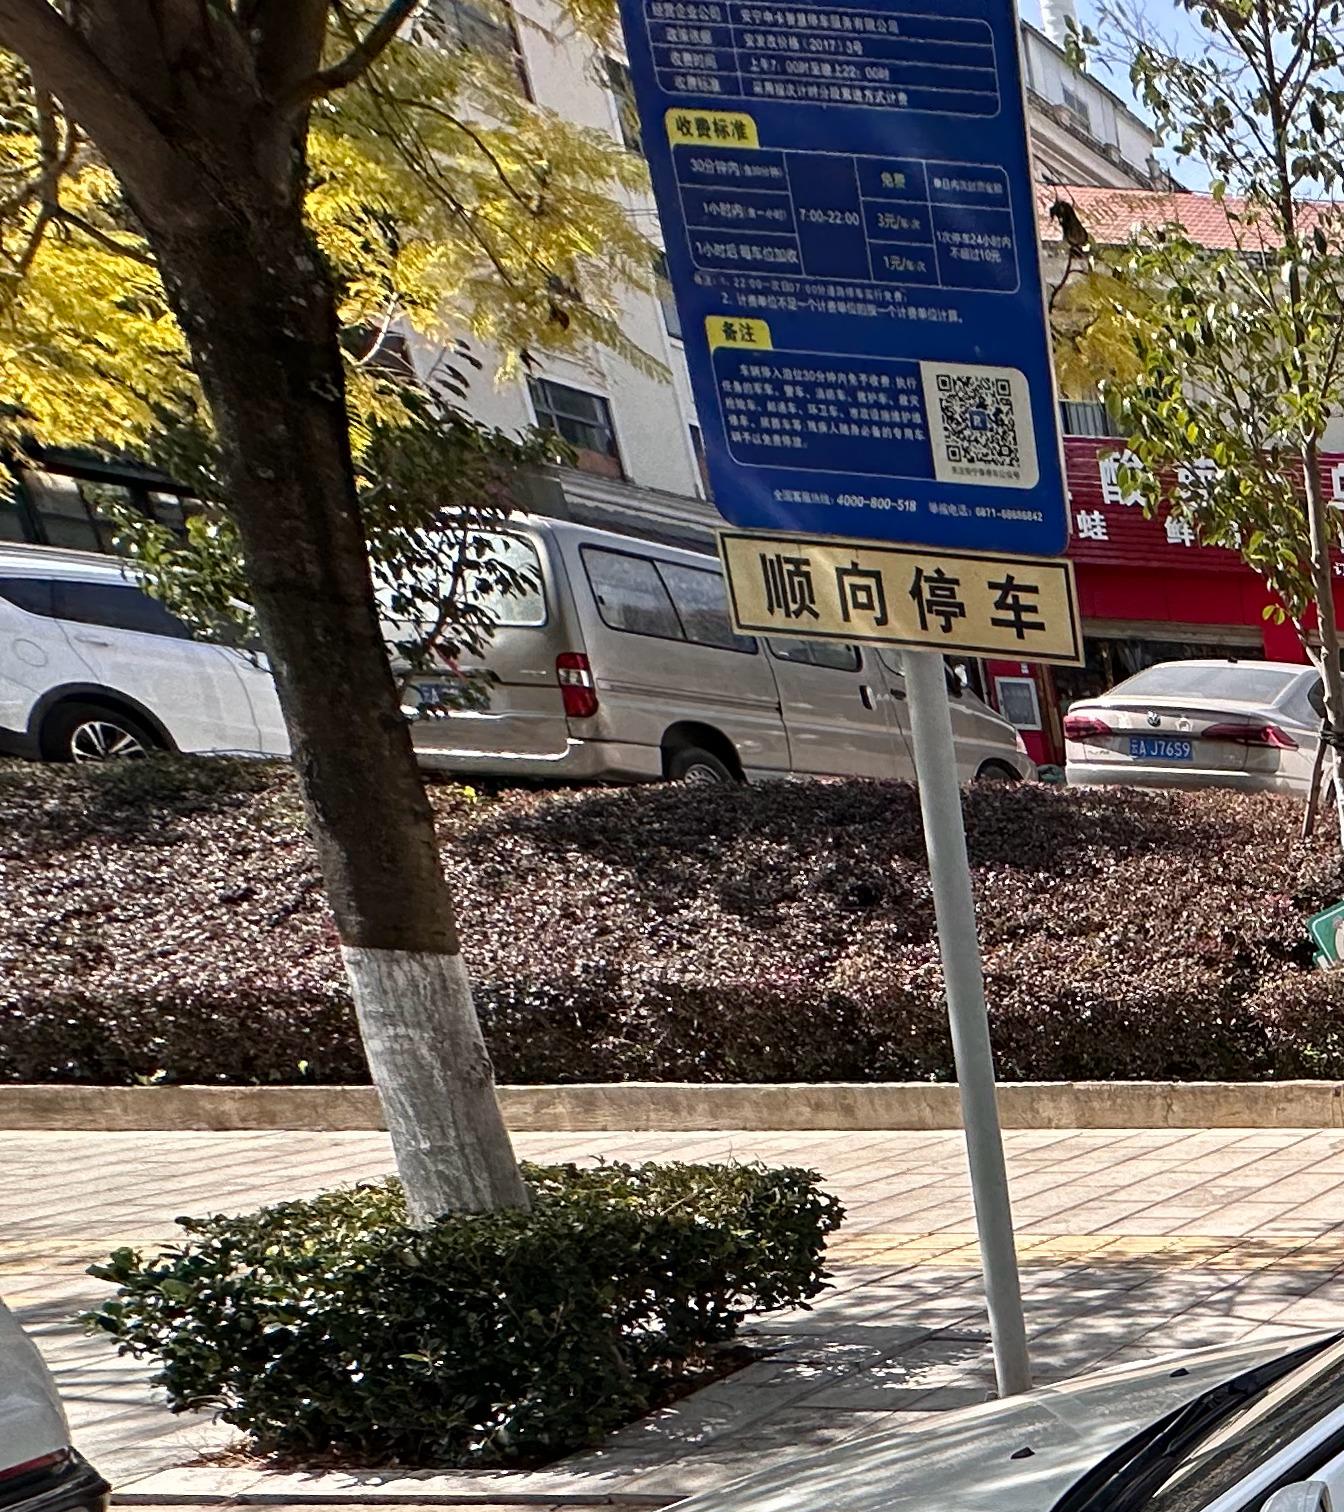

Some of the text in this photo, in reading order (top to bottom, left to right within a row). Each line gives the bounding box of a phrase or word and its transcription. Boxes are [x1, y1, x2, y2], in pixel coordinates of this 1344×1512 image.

[675, 115, 749, 141] 收费标准
[799, 208, 860, 226] 7:00-22:00
[722, 321, 757, 343] 备注
[759, 552, 1047, 641] 顺向停车
